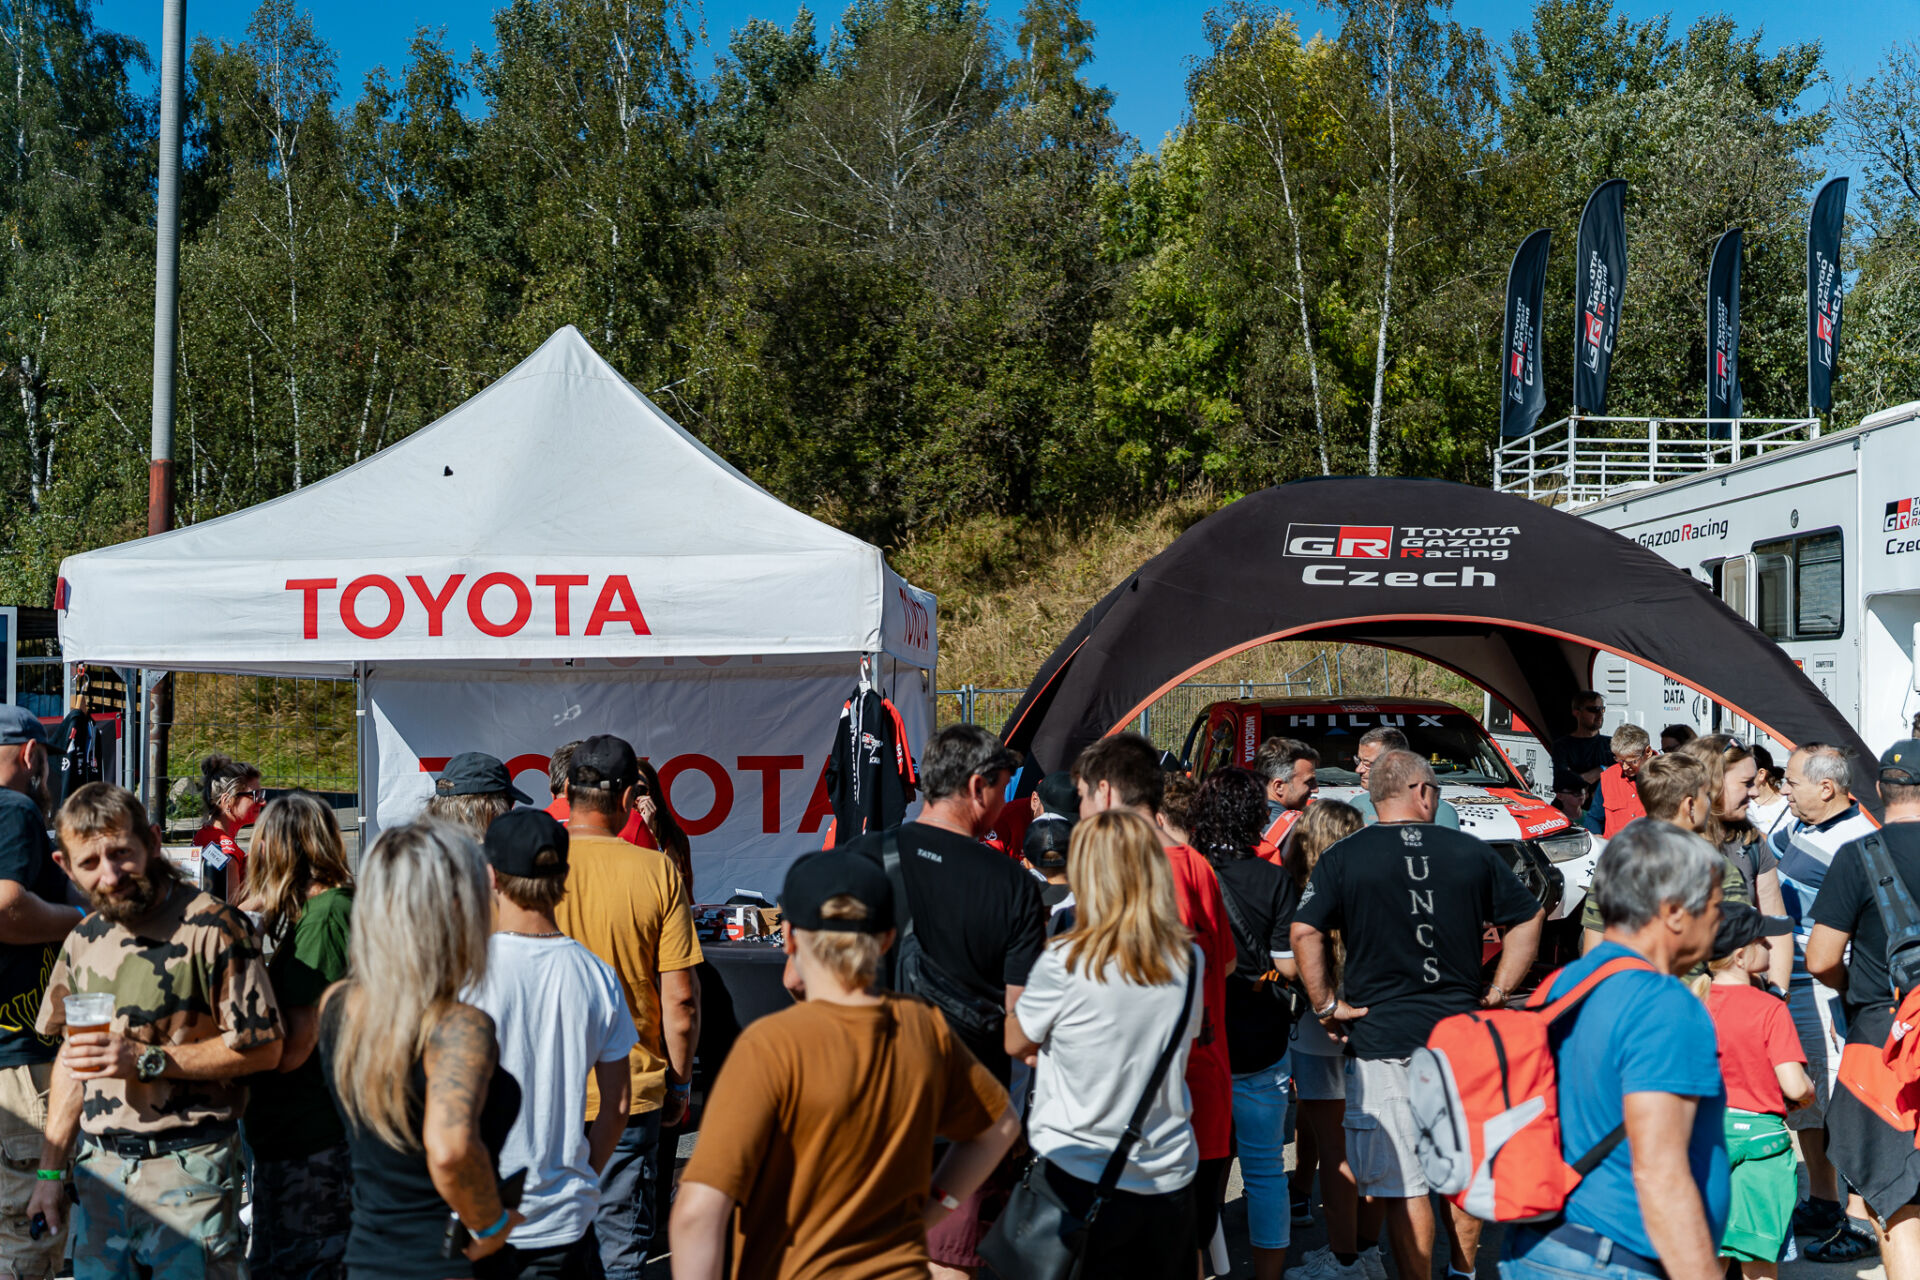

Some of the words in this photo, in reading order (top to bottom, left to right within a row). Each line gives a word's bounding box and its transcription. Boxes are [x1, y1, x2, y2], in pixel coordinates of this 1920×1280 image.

[1884, 511, 1910, 532] GR
[1400, 526, 1521, 537] TOYOTA
[1400, 537, 1511, 547] GAZOO
[1400, 548, 1509, 561] Racing
[1302, 565, 1496, 587] Czech
[285, 571, 652, 640] TOYOTA
[1663, 690, 1686, 704] DATA
[1290, 714, 1444, 727] HILUX
[1245, 715, 1256, 763] MUSICDATA
[1526, 817, 1568, 835] agados
[917, 848, 943, 863] TATRA
